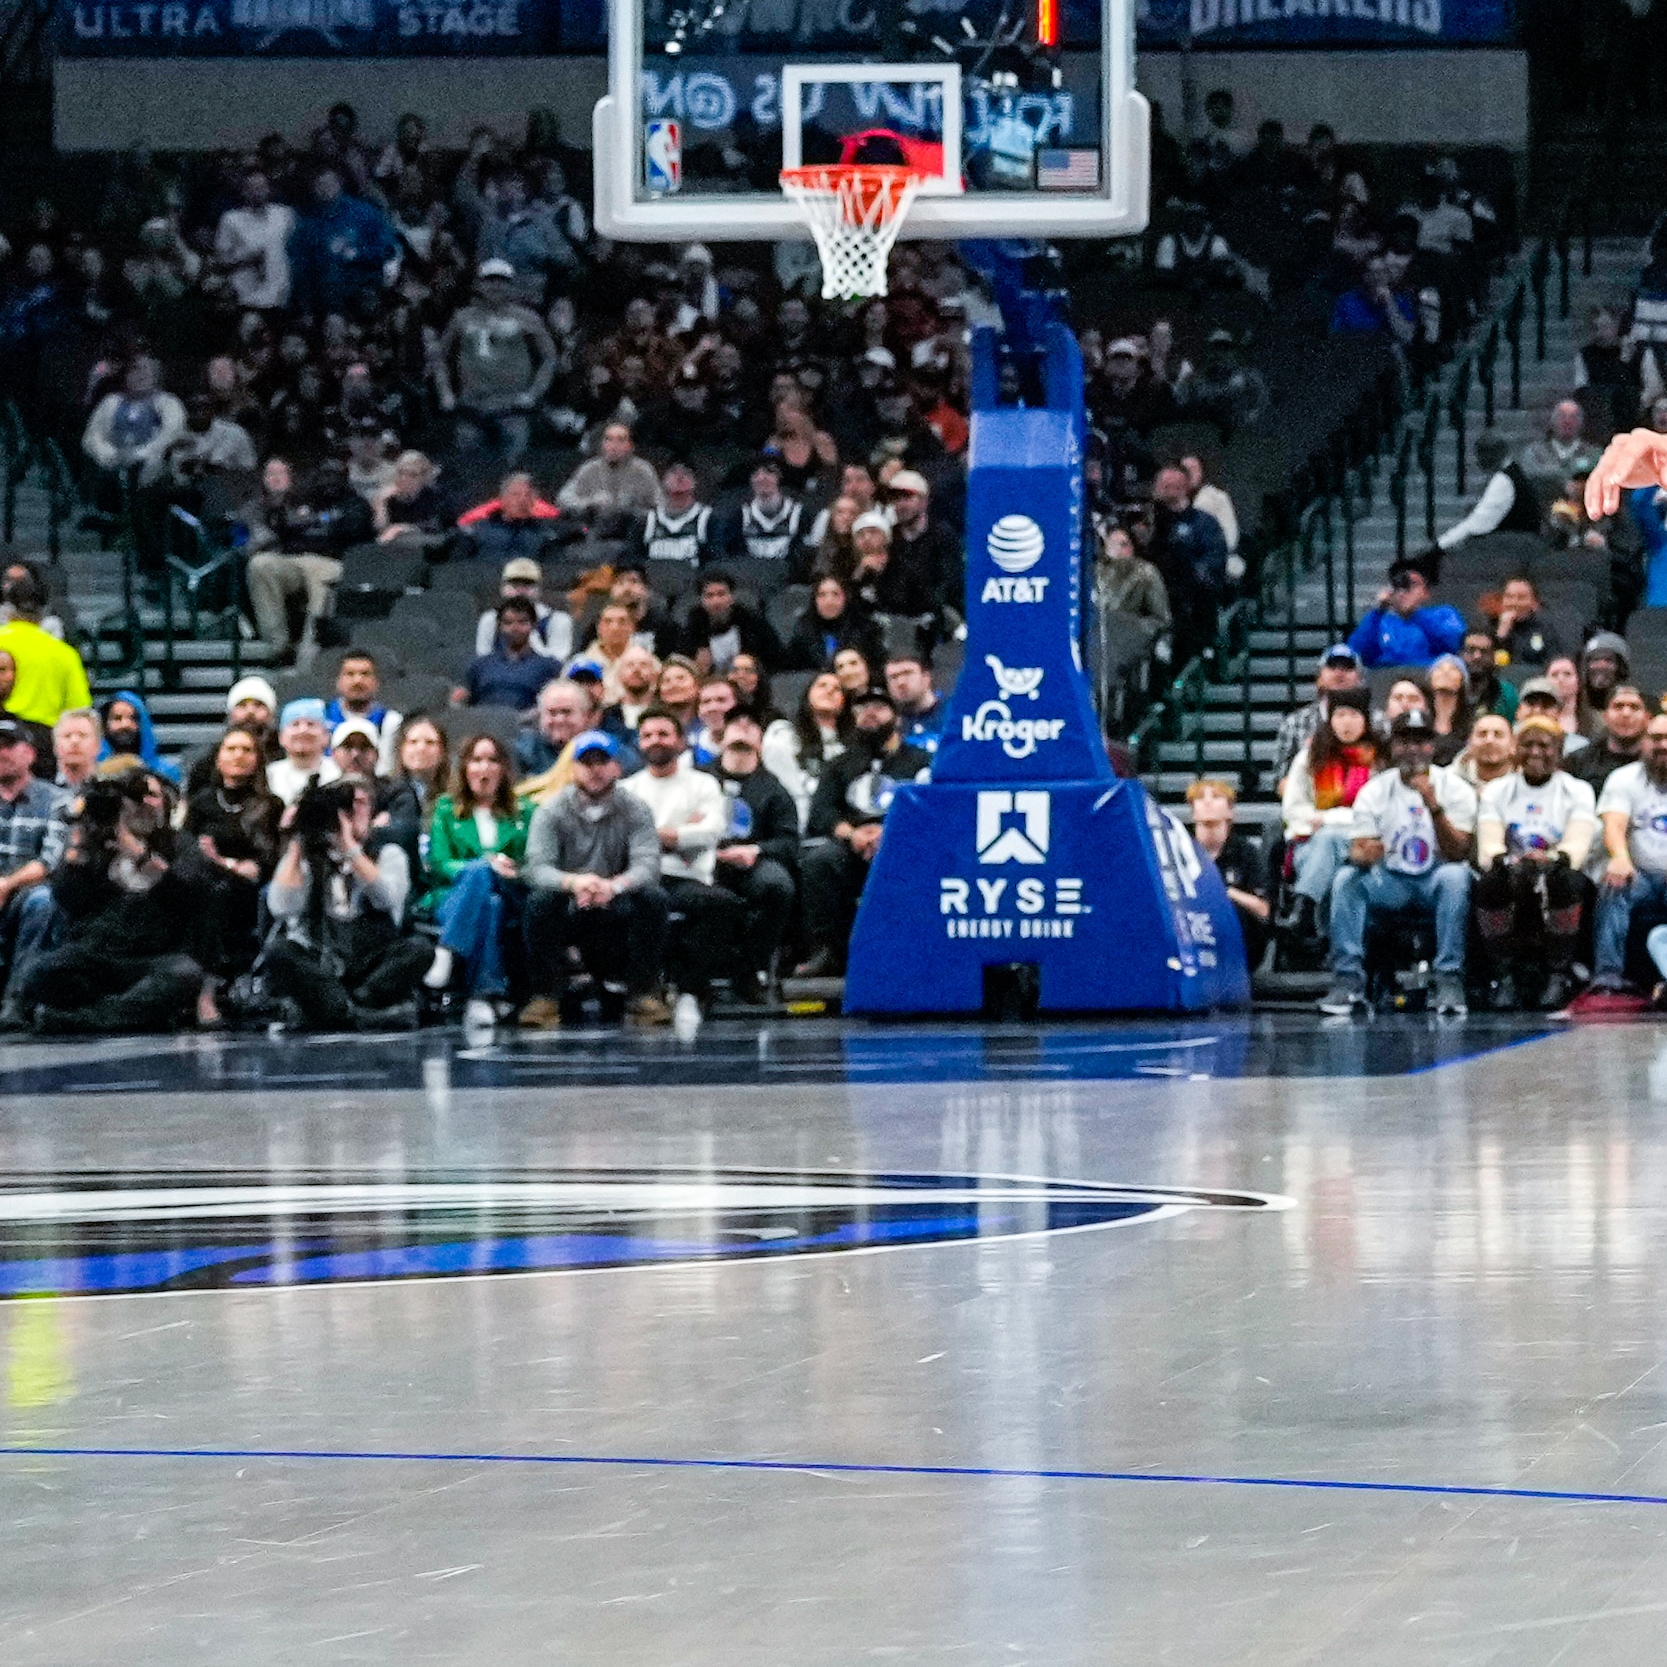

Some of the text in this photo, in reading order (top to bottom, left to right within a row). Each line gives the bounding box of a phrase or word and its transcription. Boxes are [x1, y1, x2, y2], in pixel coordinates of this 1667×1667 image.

[73, 3, 219, 39] ULTRA
[395, 6, 522, 38] STAGE
[981, 576, 1050, 604] AT&T
[962, 700, 1066, 759] Kroger
[940, 878, 1085, 915] RYSE
